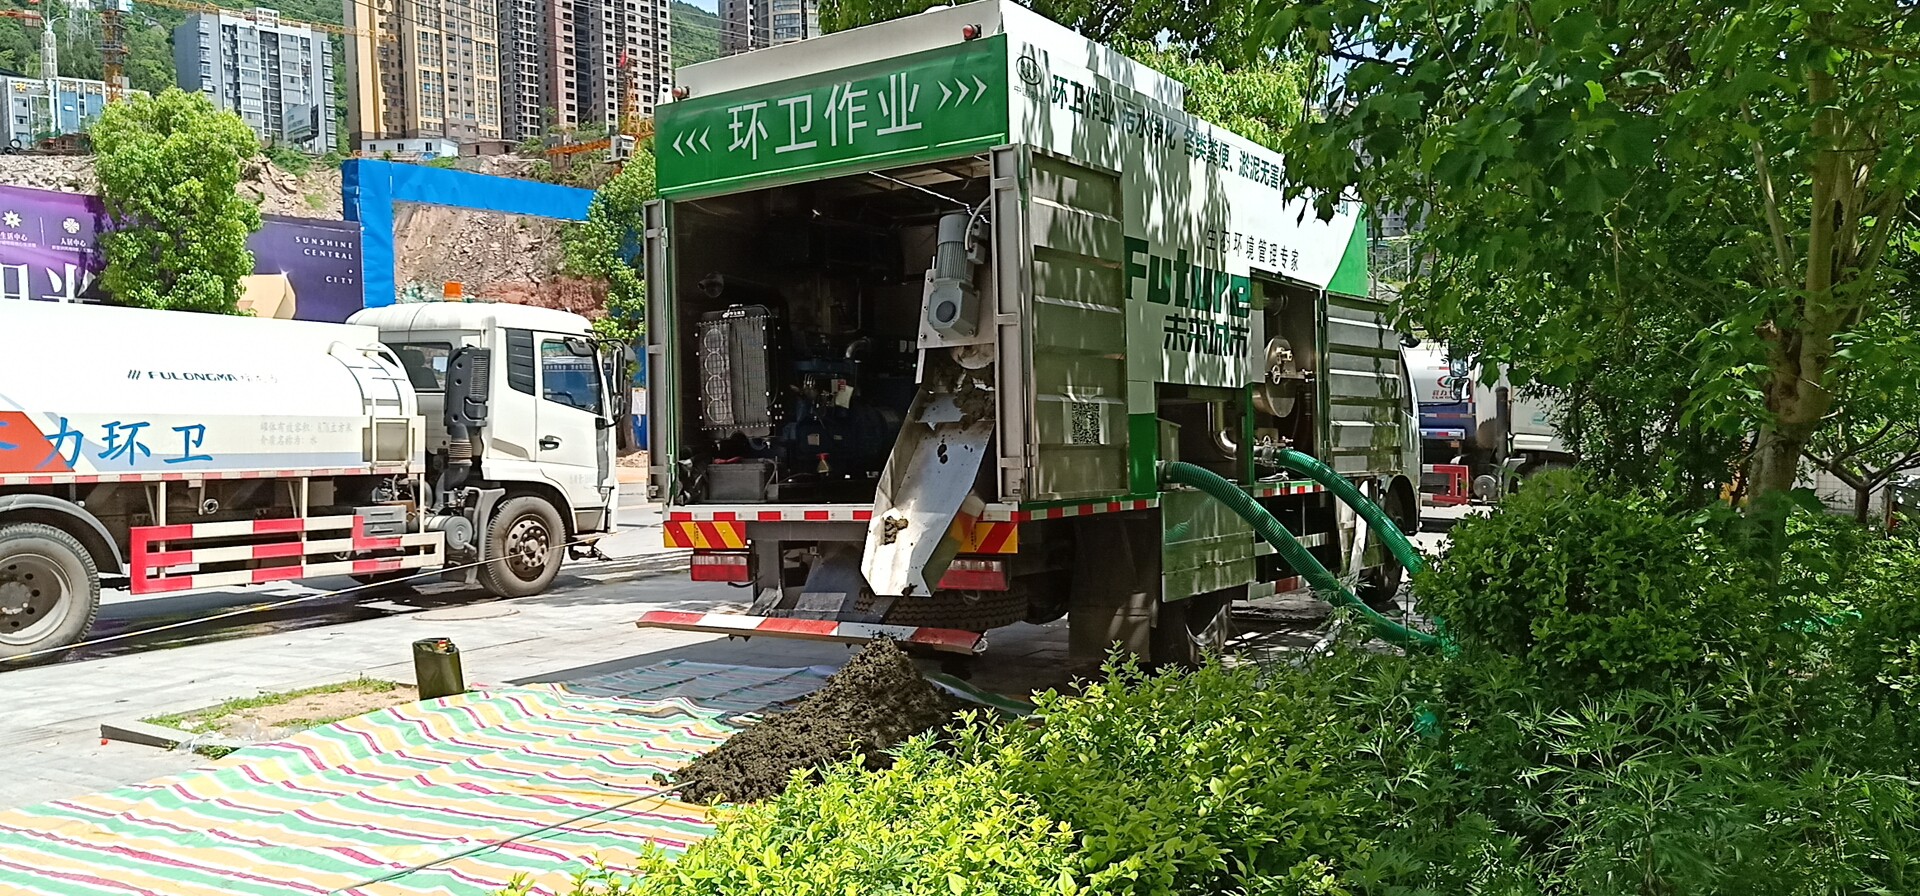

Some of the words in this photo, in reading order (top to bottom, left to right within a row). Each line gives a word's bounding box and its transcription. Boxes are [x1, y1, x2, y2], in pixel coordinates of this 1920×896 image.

[727, 72, 922, 161] 环卫作业
[1052, 74, 1115, 126] 环卫作业
[1122, 102, 1177, 150] 污水净化
[295, 236, 353, 249] SUNSHINE
[303, 248, 353, 260] CENTRAL
[1206, 224, 1299, 272] 生态环境管理专家
[325, 275, 353, 285] CITY
[1124, 235, 1251, 319] Future
[1163, 313, 1250, 358] 未来城市
[147, 371, 238, 382] FULONGMA
